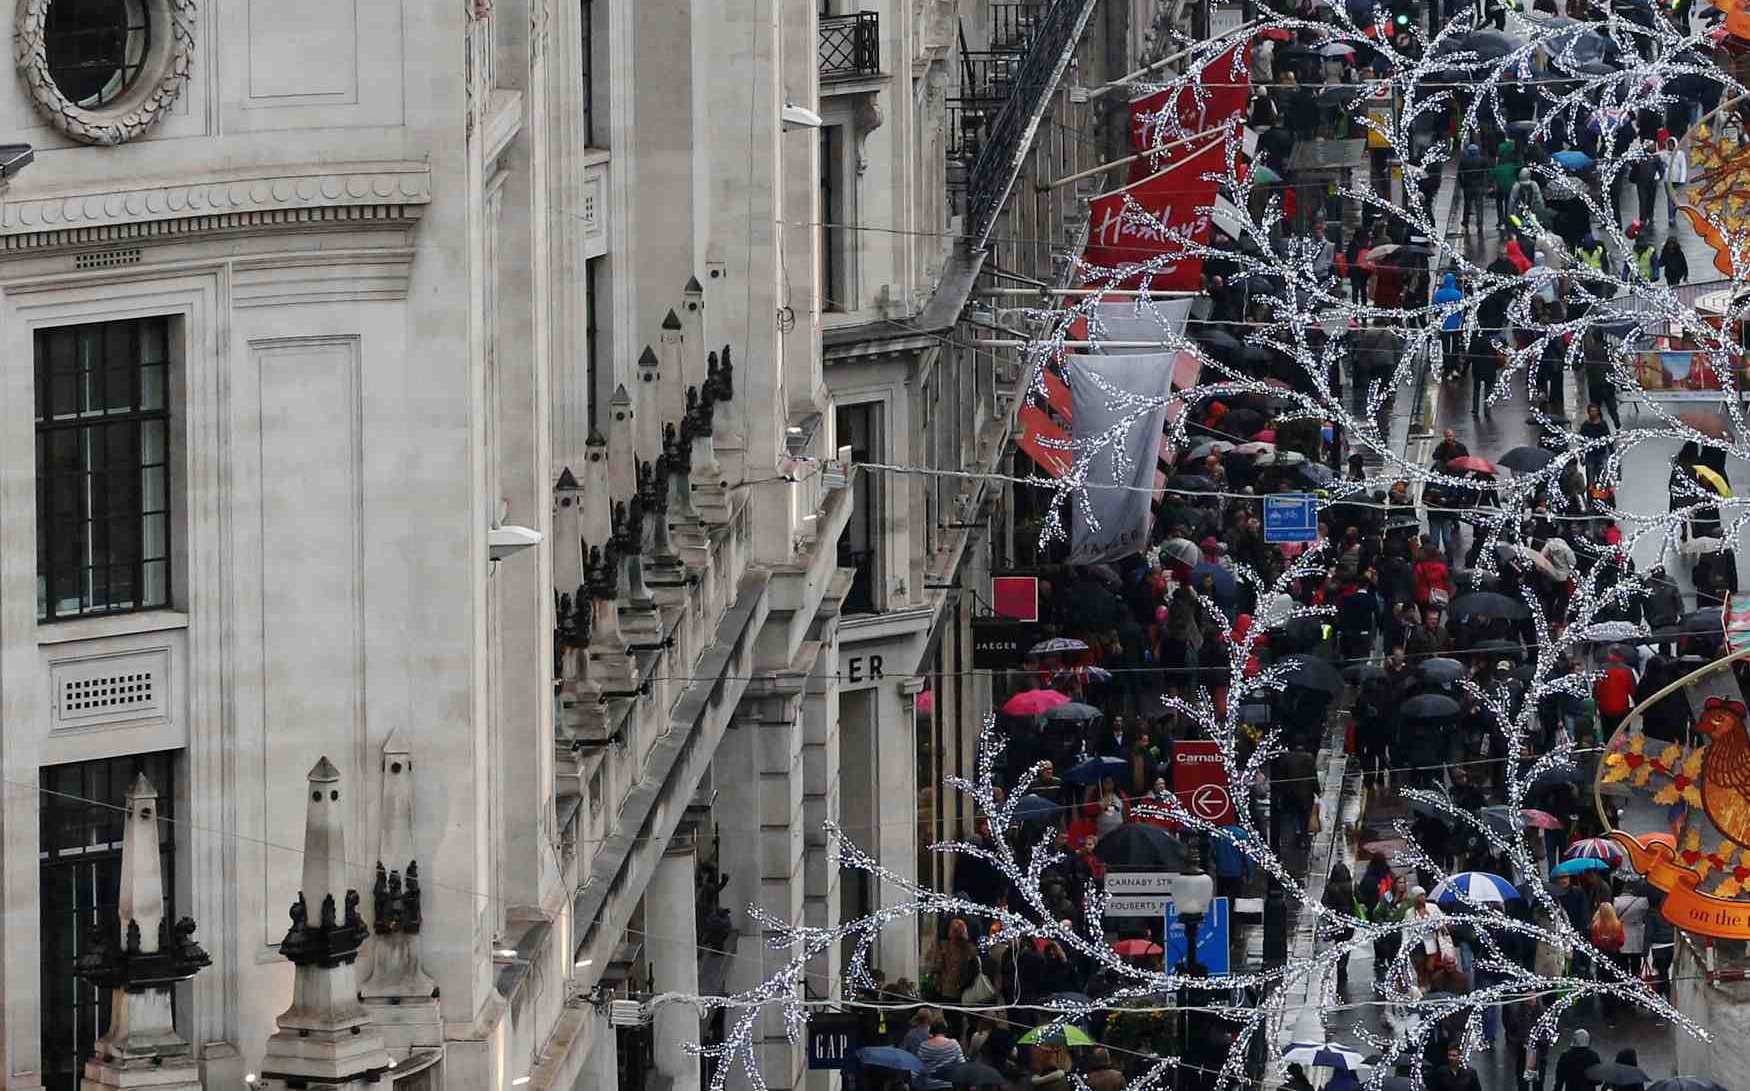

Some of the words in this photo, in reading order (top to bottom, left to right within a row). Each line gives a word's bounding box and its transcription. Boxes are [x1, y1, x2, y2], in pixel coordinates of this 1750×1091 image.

[975, 642, 1017, 650] JAEGER
[1107, 878, 1153, 887] CARNABY
[1689, 909, 1710, 923] on
[1715, 909, 1742, 926] the
[816, 1034, 847, 1059] GAP
